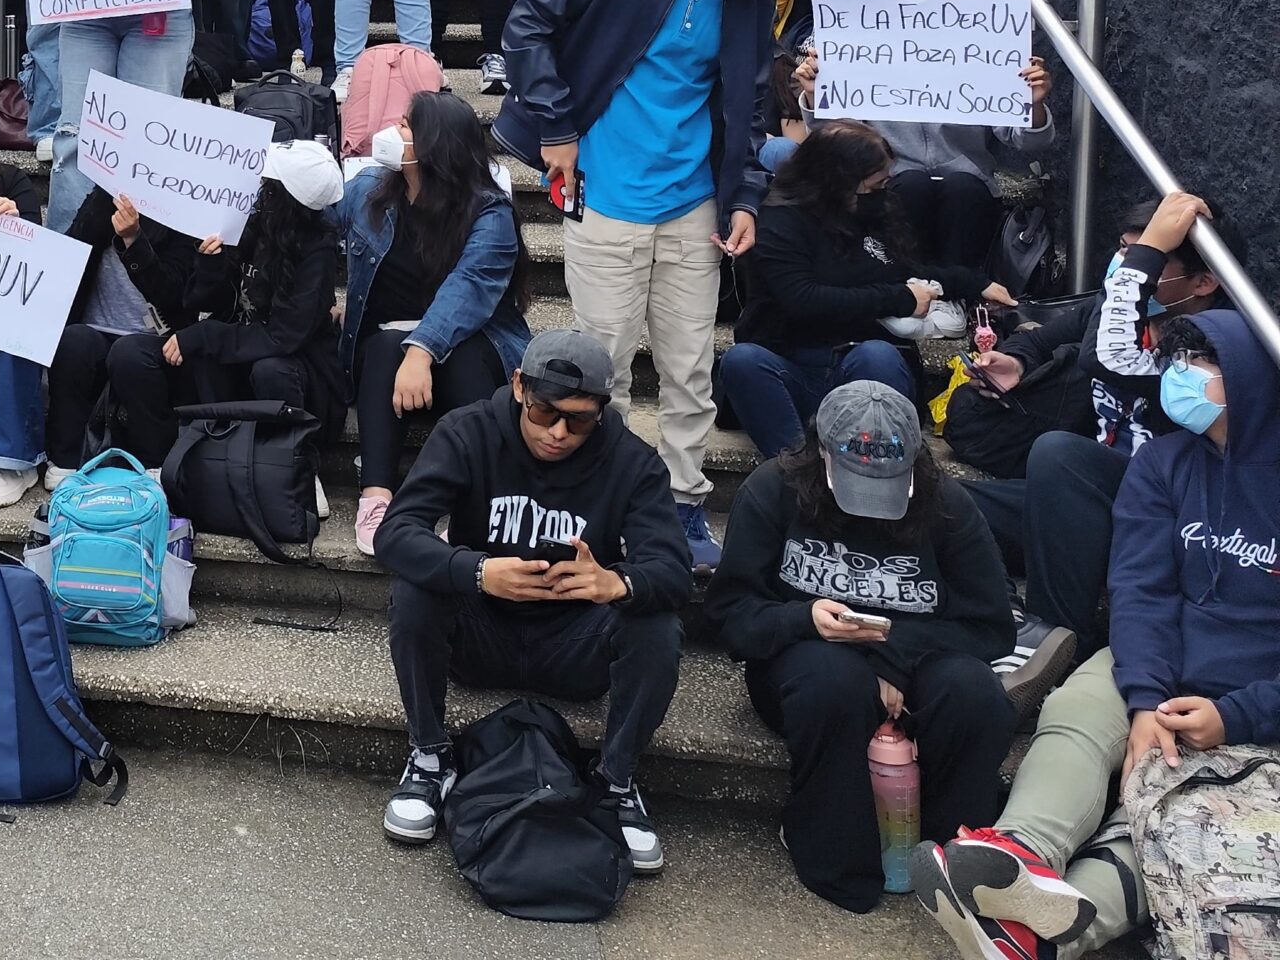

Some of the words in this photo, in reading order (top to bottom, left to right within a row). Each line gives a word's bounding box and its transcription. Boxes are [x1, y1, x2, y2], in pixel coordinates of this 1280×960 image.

[818, 3, 849, 30] DE
[861, 4, 890, 30] LA
[822, 40, 893, 65] PARA
[903, 39, 956, 66] POZA
[964, 42, 1022, 68] RICA
[871, 83, 952, 110] ESTÁN
[144, 118, 267, 176] OLVIDAMOS
[132, 162, 258, 216] PERDONAMOS
[1108, 307, 1128, 335] OUR
[782, 553, 940, 604] ANGELES
